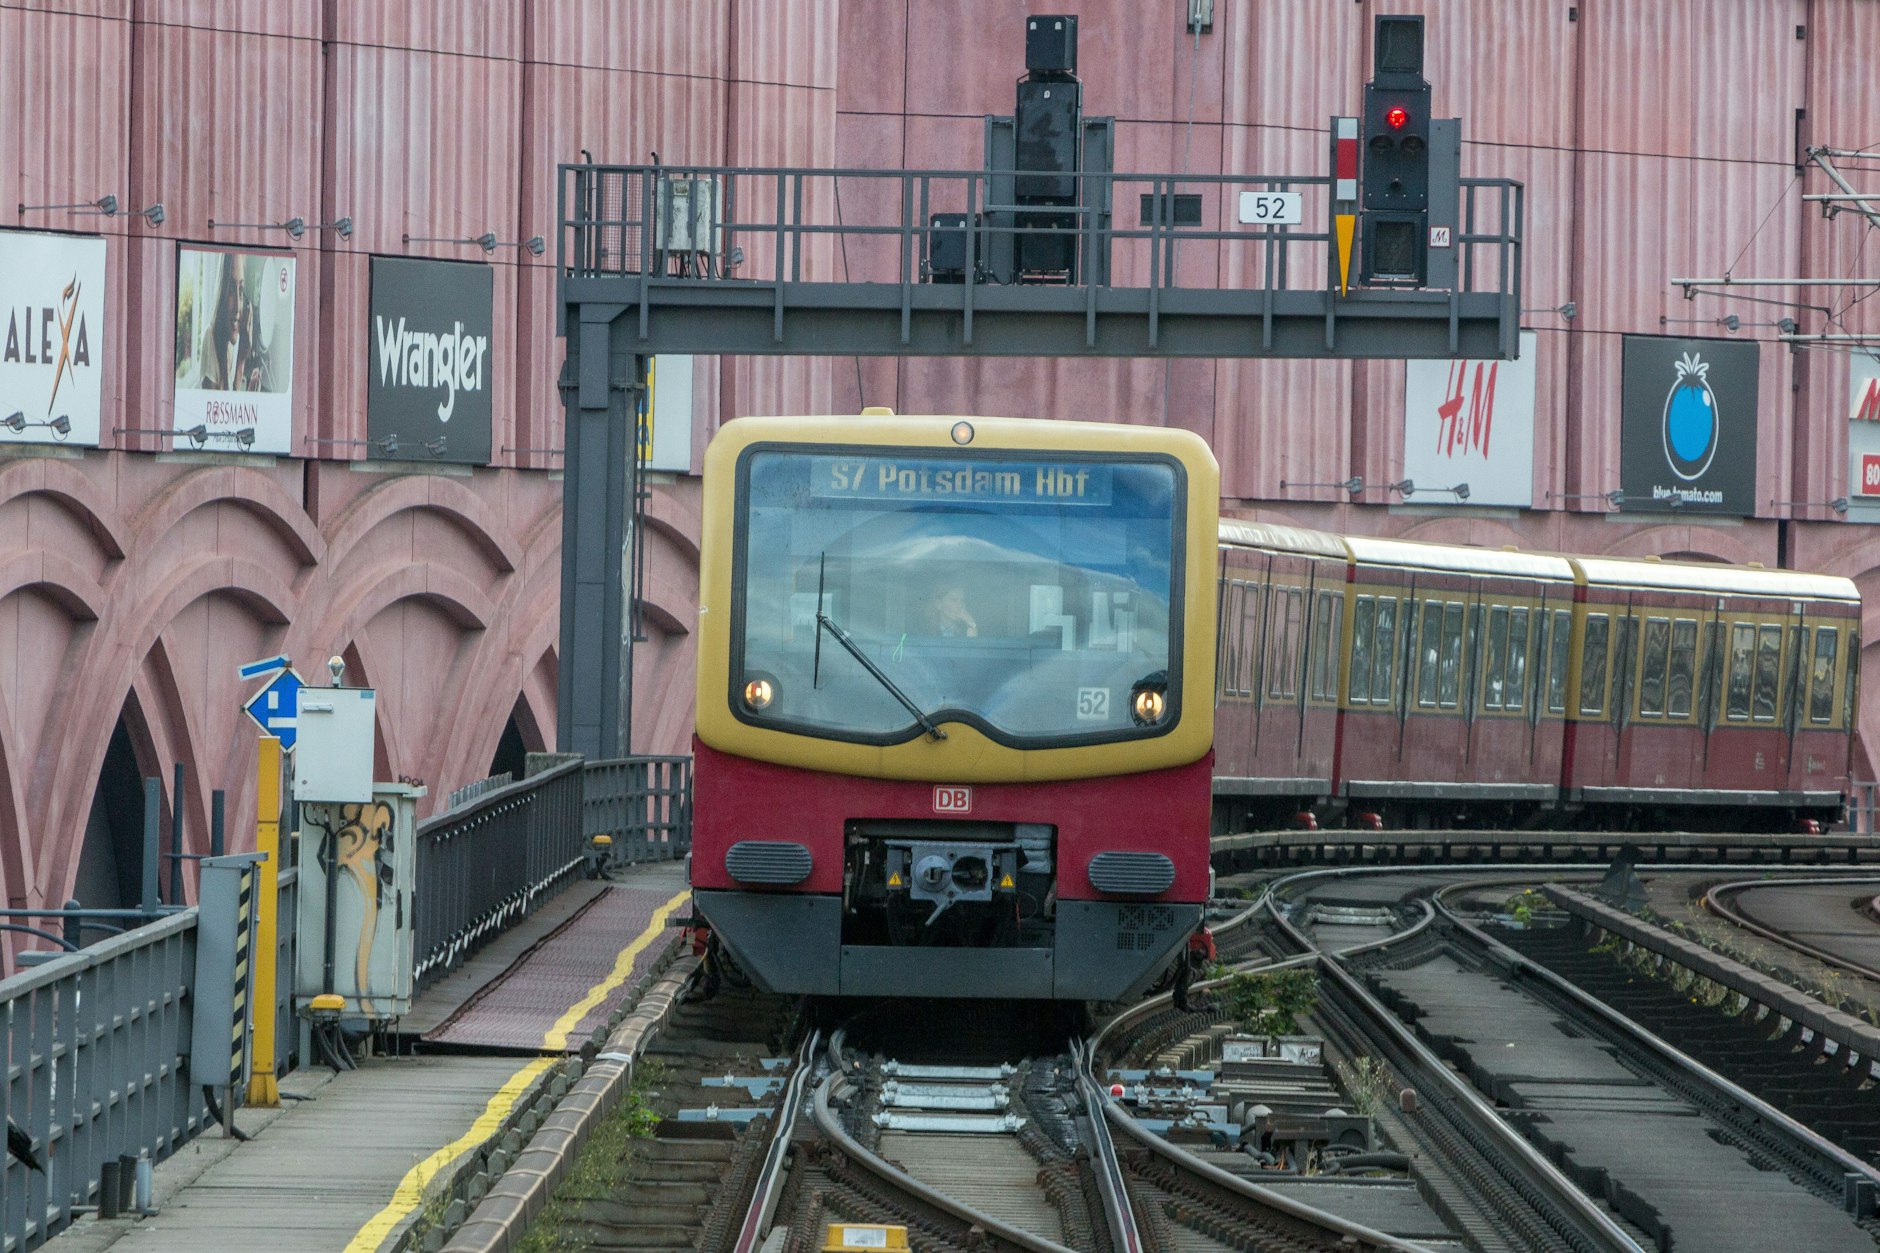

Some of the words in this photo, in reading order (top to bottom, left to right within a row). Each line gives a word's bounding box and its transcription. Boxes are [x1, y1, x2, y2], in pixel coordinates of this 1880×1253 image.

[1256, 197, 1286, 219] 52
[4, 279, 90, 416] ALEXA
[376, 315, 487, 423] Wrangler
[206, 401, 258, 425] ROSSMANN
[1437, 359, 1498, 460] H&M
[831, 463, 866, 491] S7
[878, 464, 1021, 496] Potsdam
[1036, 466, 1090, 497] Hbf
[1080, 691, 1106, 715] 52
[938, 789, 967, 808] DB
